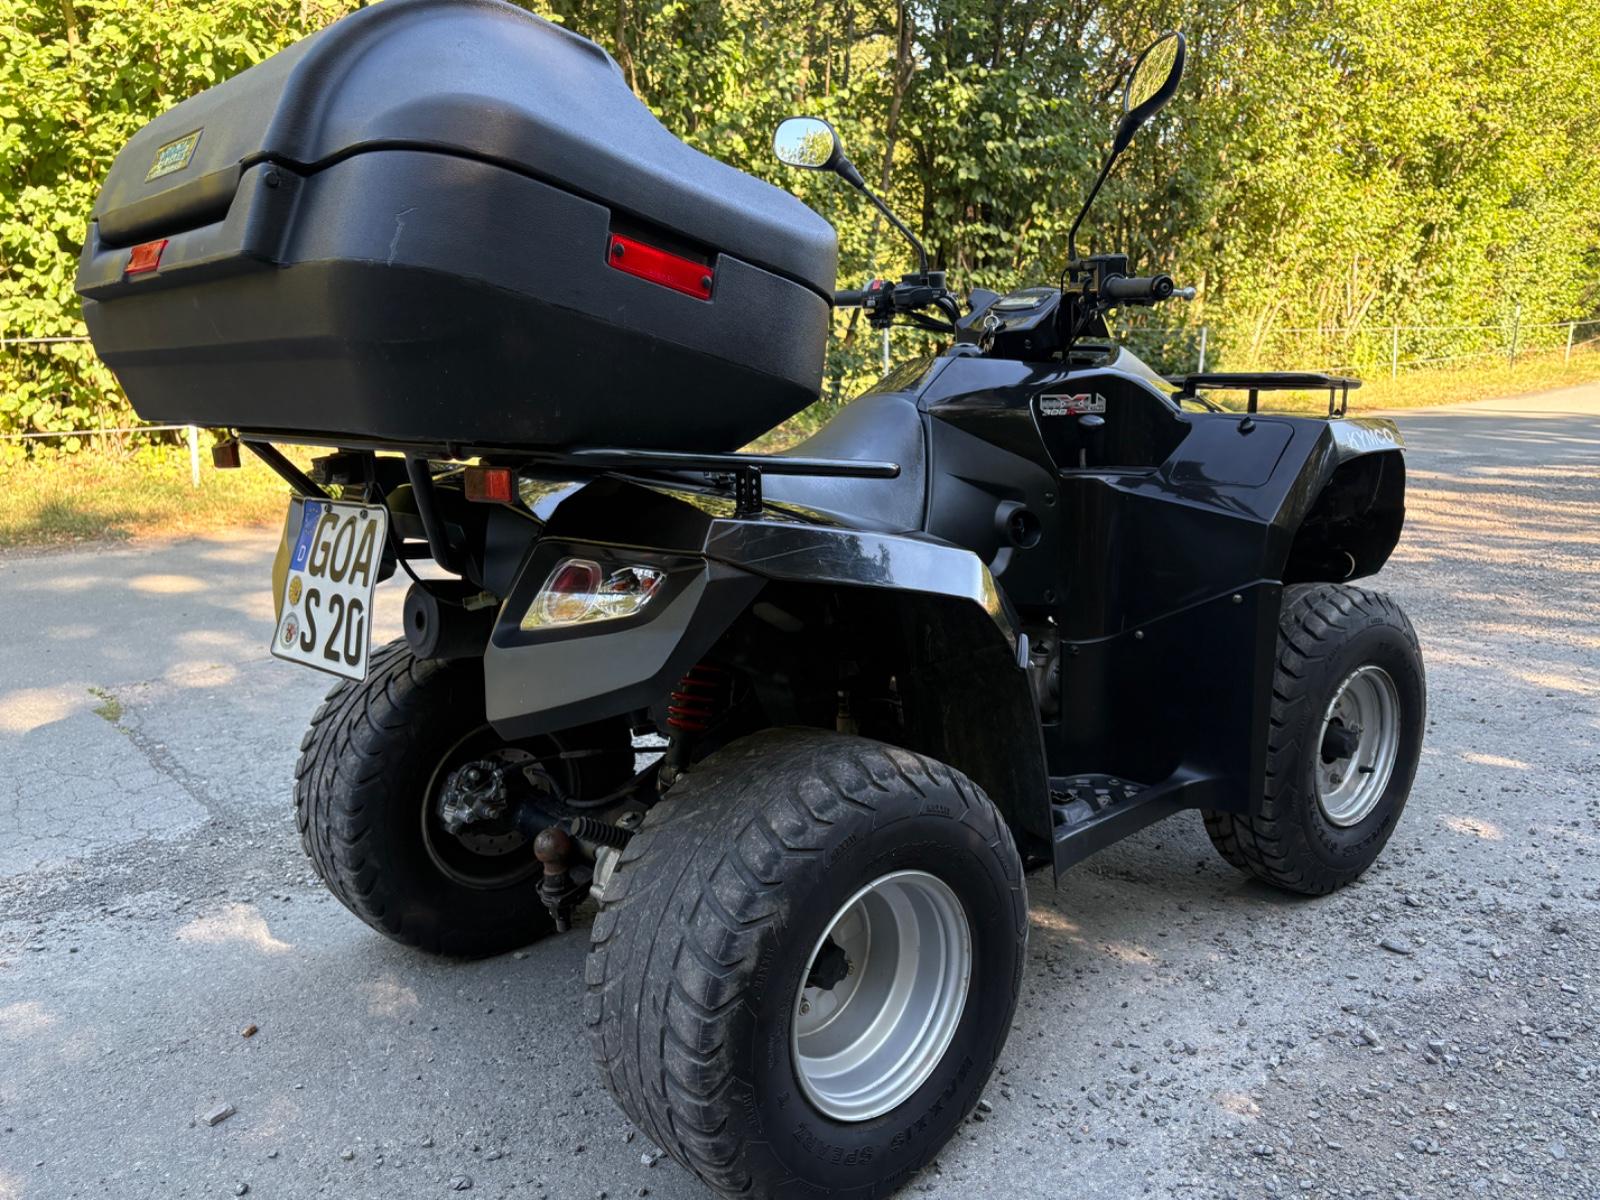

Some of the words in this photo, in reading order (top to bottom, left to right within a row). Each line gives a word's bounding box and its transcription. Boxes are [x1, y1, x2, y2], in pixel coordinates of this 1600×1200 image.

[1346, 428, 1395, 448] KYMCO
[297, 545, 307, 561] D
[308, 512, 378, 588] GOA
[300, 588, 321, 652] S
[323, 593, 364, 666] 20
